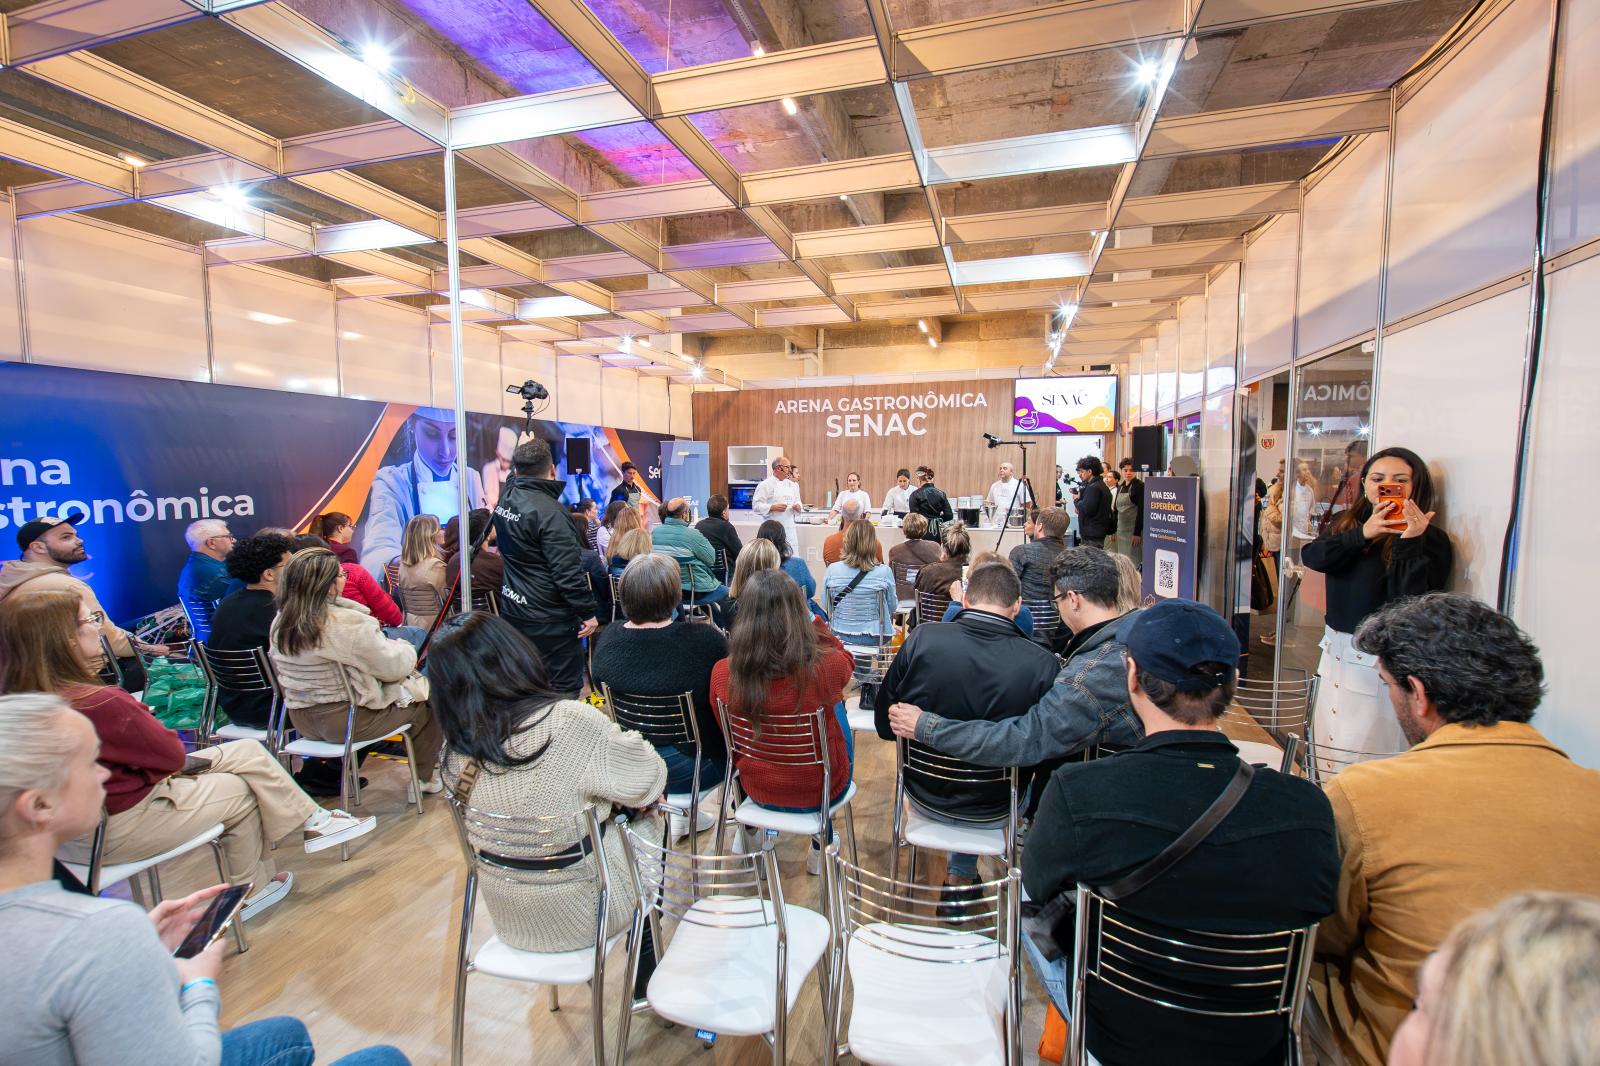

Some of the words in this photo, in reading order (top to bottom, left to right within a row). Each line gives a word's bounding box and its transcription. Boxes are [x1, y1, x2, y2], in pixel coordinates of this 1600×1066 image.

[775, 399, 834, 414] ARENA
[837, 391, 988, 412] GASTRONÔMICA
[826, 412, 928, 438] SENAC
[0, 458, 71, 486] na
[1151, 491, 1162, 499] VIVA
[1163, 491, 1176, 500] ESSA
[1151, 502, 1184, 512] EXPERIÊNCIA
[1150, 512, 1161, 520] COM
[1162, 513, 1166, 521] A
